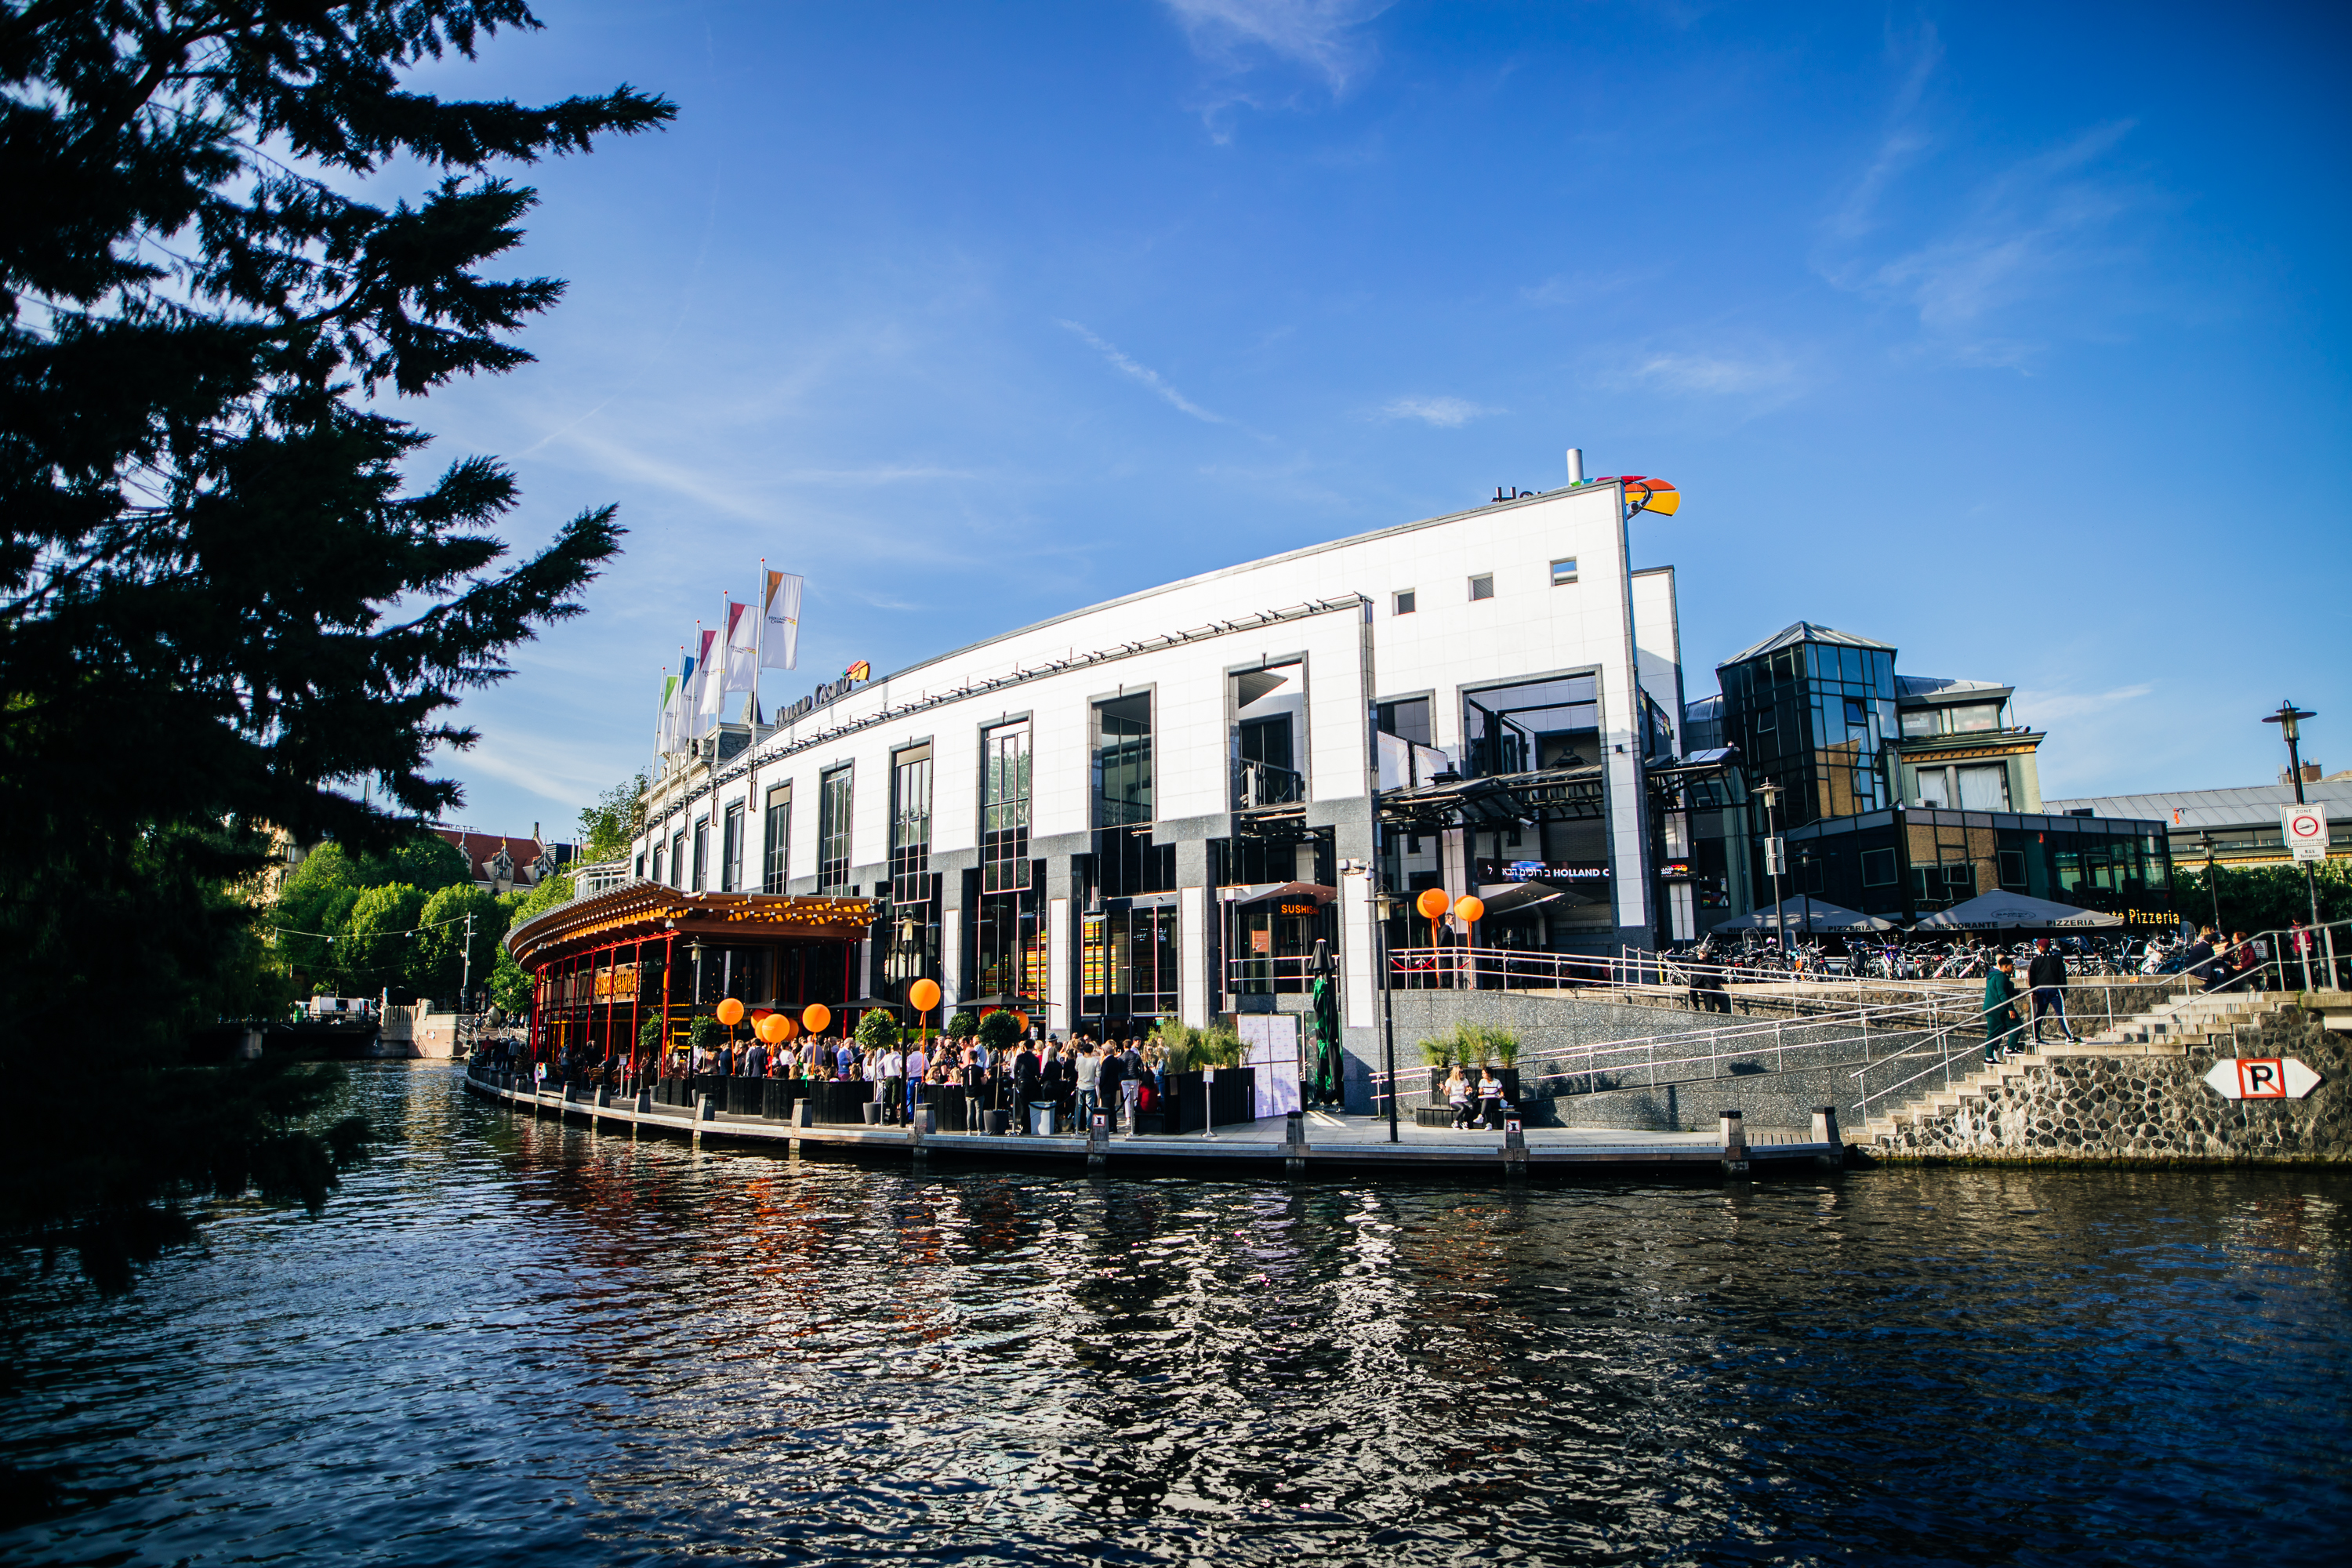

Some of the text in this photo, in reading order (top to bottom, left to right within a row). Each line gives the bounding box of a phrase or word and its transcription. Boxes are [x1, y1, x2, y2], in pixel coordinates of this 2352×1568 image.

[774, 675, 852, 729] HOLLAND CASINO
[1553, 869, 1600, 877] HOLLAND
[1934, 921, 1999, 930] RISTORANTE
[2129, 909, 2180, 924] Pizzeria
[595, 972, 637, 996] SUSH SAMBA
[2249, 1065, 2274, 1091] P
